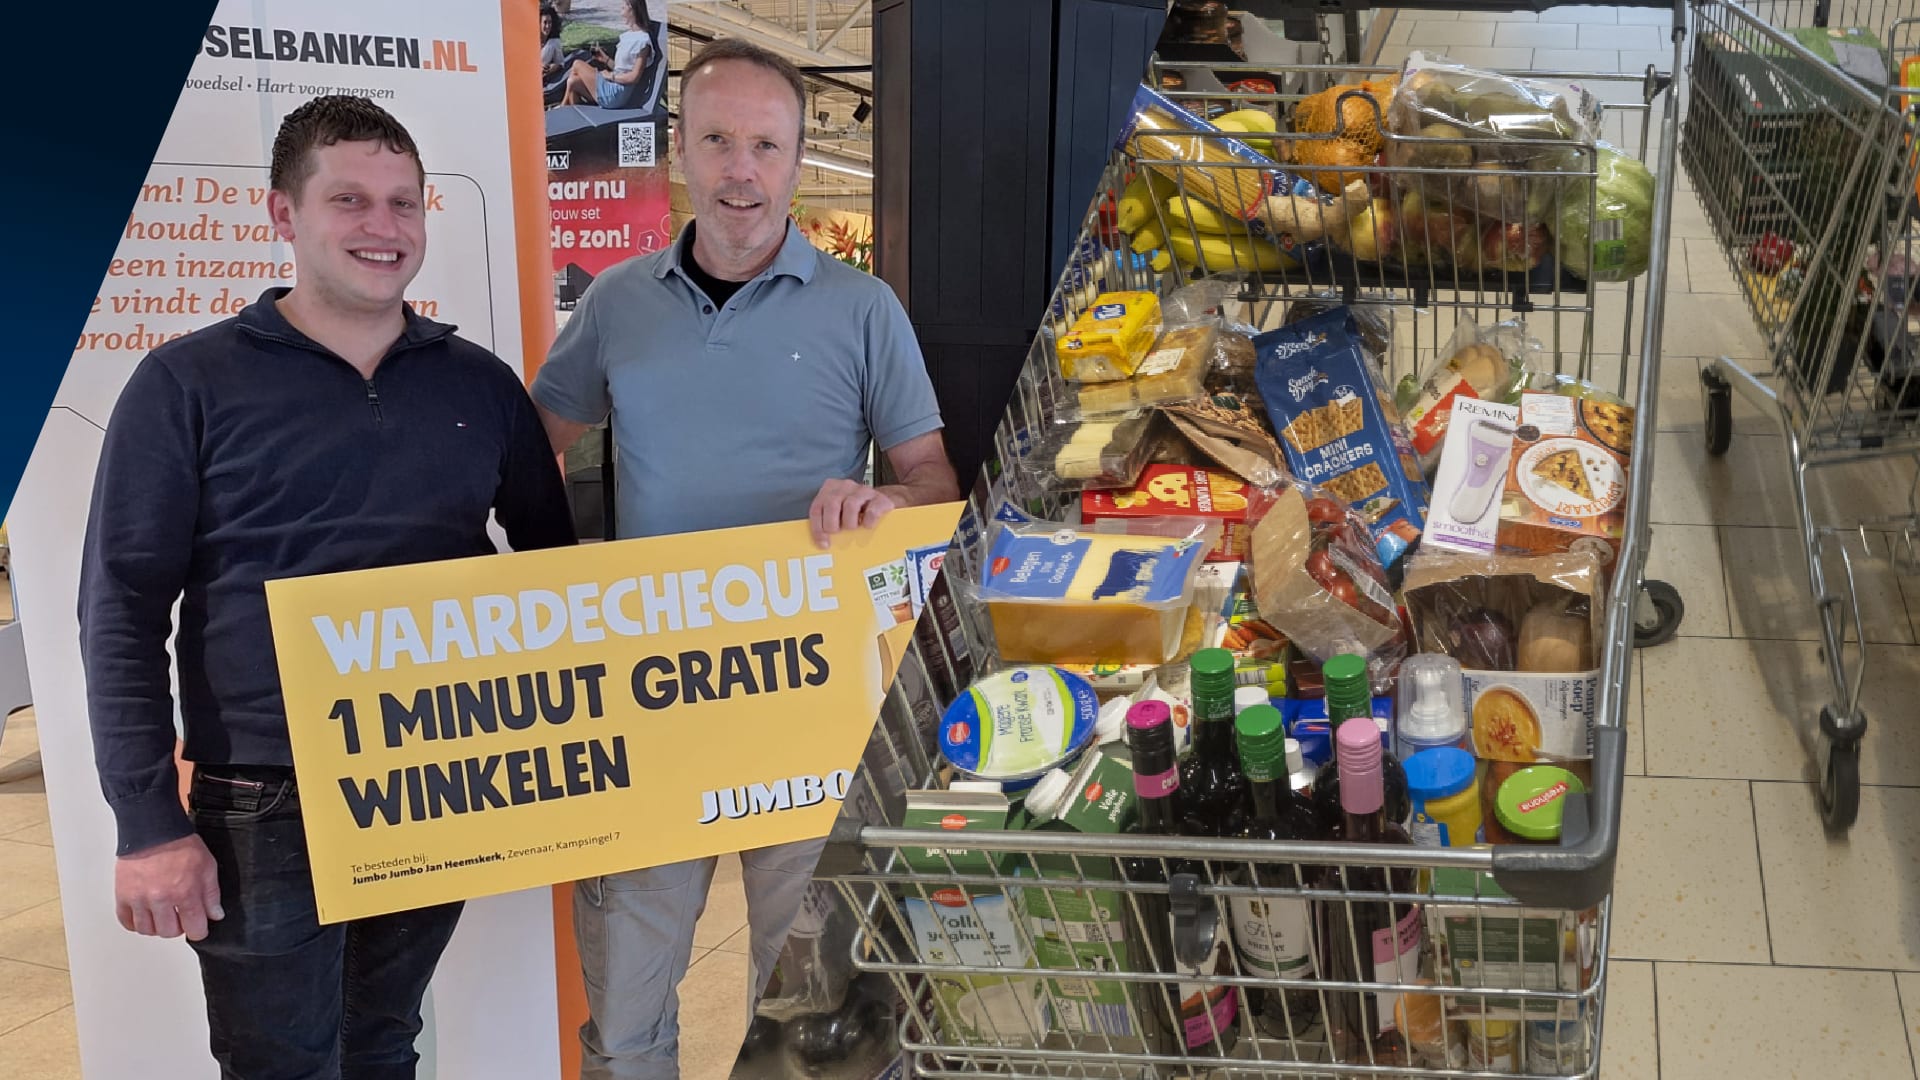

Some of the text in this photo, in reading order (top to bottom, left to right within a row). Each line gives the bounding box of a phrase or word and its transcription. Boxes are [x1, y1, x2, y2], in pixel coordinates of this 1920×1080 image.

[199, 25, 478, 72] SELBANKEN.NL
[256, 78, 296, 94] Hart
[299, 84, 333, 96] voor
[336, 86, 395, 99] mensen
[194, 178, 238, 204] De
[548, 180, 626, 200] aar nu
[125, 213, 224, 241] houdt
[581, 208, 601, 219] set
[551, 224, 630, 249] de zon!
[108, 258, 166, 277] een
[111, 288, 201, 314] vindt
[210, 288, 246, 314] de
[1305, 443, 1373, 478] CRACKERS
[1319, 438, 1347, 458] MINI
[311, 552, 838, 675] WAARDECHEQUE
[328, 633, 830, 755] 1 MINUUT GRATIS
[1570, 680, 1582, 712] soep
[996, 704, 1015, 736] Magere
[338, 735, 631, 829] WINKELEN
[698, 769, 853, 824] JUMBO
[351, 853, 429, 874] Te besteden bij:
[353, 831, 621, 885] Jumbo Jumbo Jan Heemskerk, Zevenaar, Kampsingel 7
